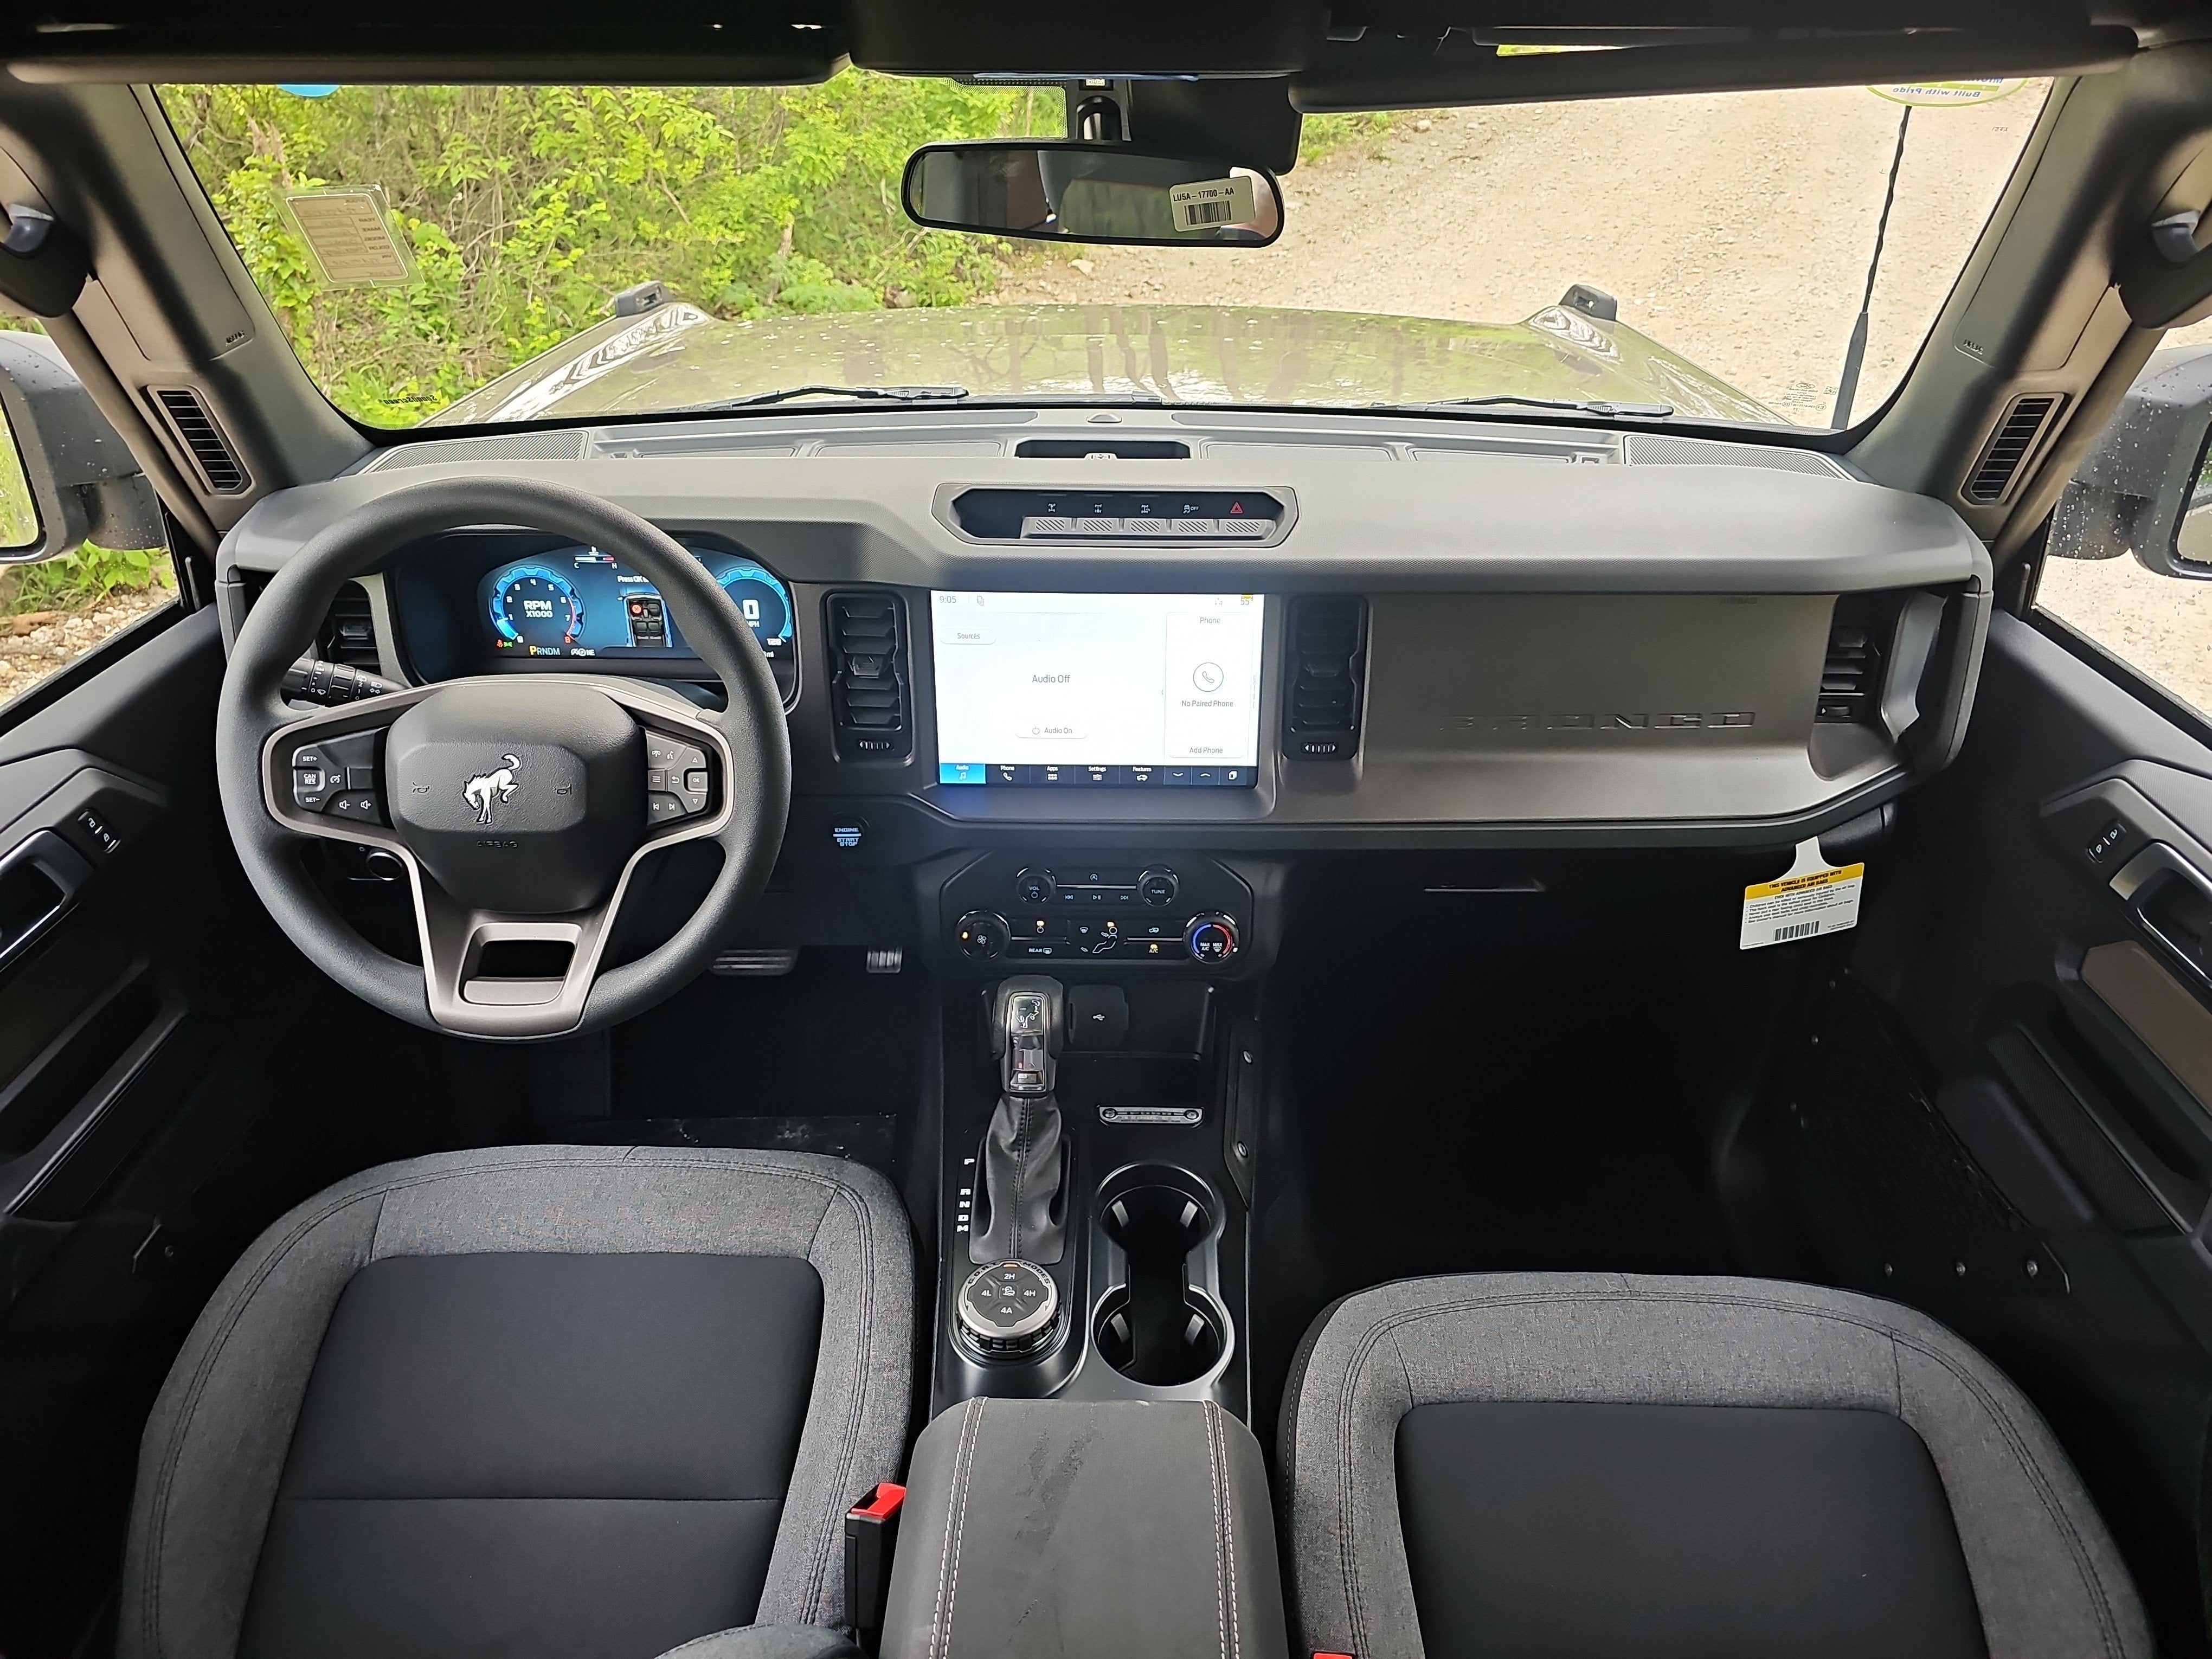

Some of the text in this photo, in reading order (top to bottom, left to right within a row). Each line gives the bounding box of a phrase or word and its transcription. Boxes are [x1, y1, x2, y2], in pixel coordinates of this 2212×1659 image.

[523, 600, 552, 610] RPM
[742, 599, 760, 619] 0
[1032, 674, 1071, 683] Audio Off
[1023, 1262, 1051, 1284] MODES
